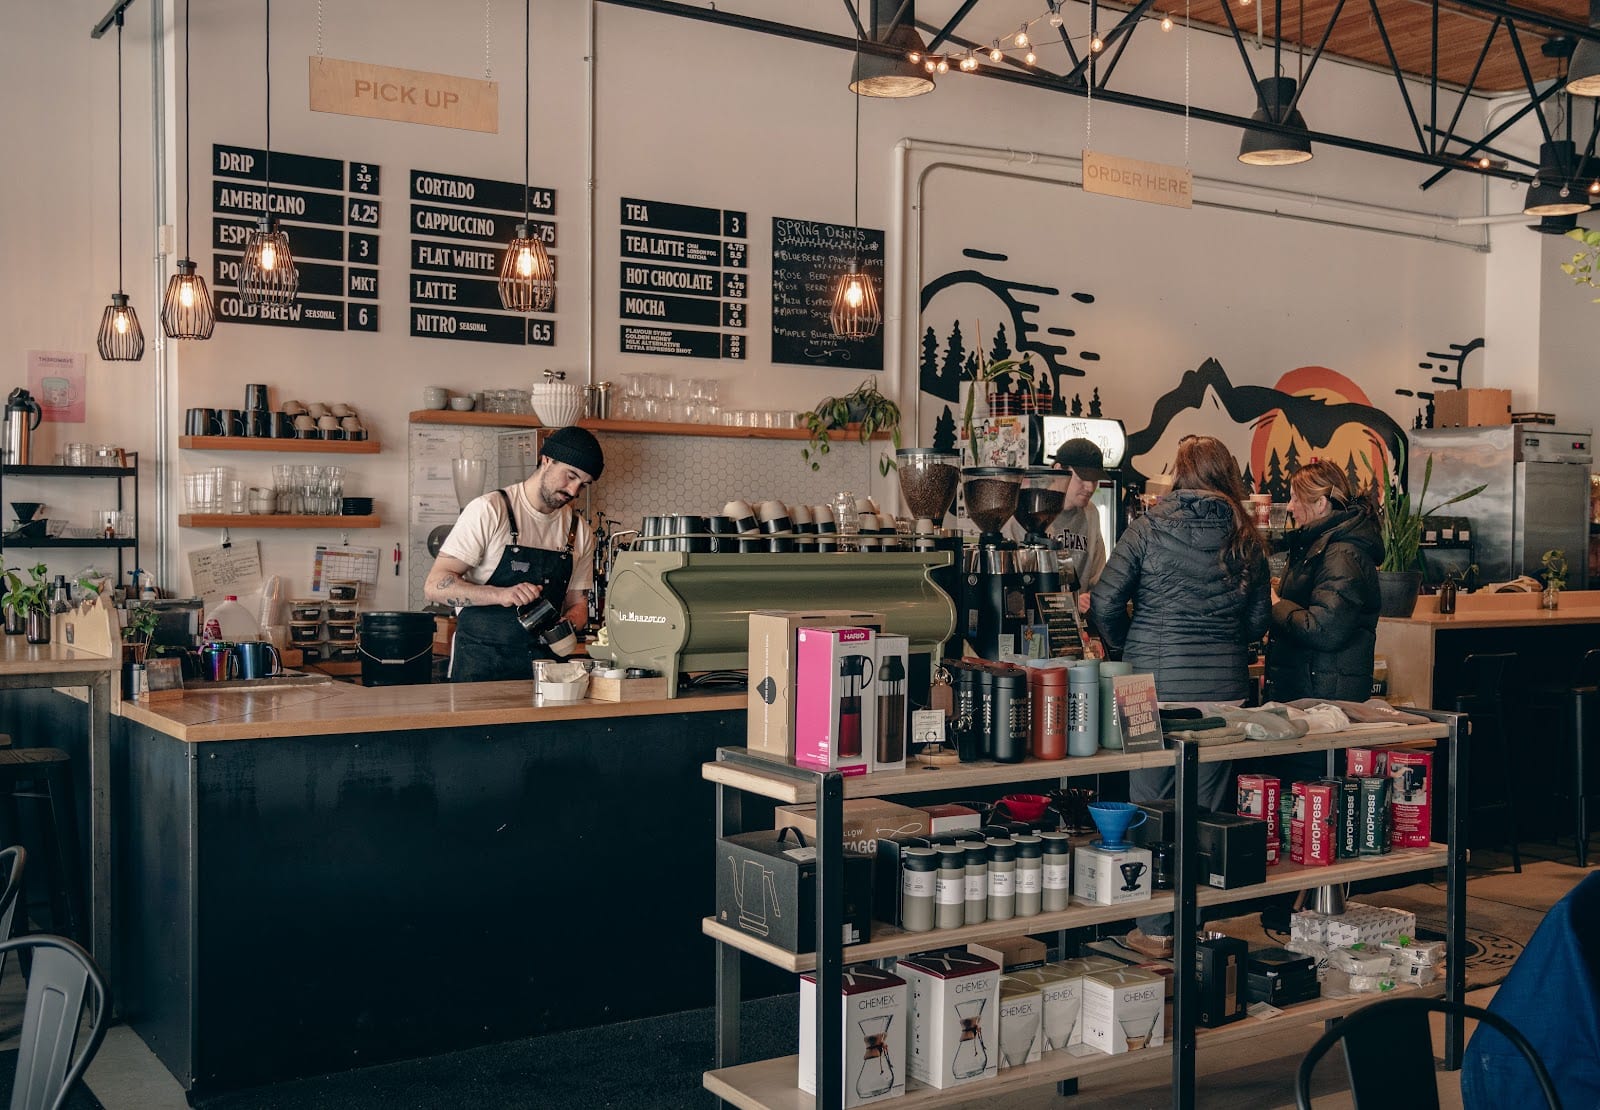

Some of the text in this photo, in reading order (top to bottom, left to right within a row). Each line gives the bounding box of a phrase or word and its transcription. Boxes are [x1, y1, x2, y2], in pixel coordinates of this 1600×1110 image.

[354, 79, 459, 109] PICK UP
[220, 152, 254, 173] DRIP
[360, 165, 367, 173] 3
[357, 173, 372, 183] 3.5
[1087, 164, 1188, 194] ORDER HERE
[360, 183, 369, 191] 4
[416, 176, 475, 200] CORTADO
[220, 188, 306, 216] AMERICANO
[533, 191, 552, 209] 4.5
[350, 204, 378, 224] 4.25
[626, 204, 649, 222] TEA
[416, 211, 495, 237] CAPPUCCINO
[731, 217, 740, 233] 3
[359, 240, 369, 257] 3
[626, 236, 684, 257] TEA LATTE
[727, 243, 745, 252] 4.75
[418, 246, 495, 270] FLAT WHITE
[730, 251, 742, 259] 5.5
[351, 276, 377, 292] MKT
[626, 267, 713, 291] HOT CHOCOLATE
[727, 281, 744, 290] 4.75
[733, 274, 739, 282] 4
[416, 280, 457, 301] LATTE
[220, 298, 337, 322] COLD BREW SEASONAL
[625, 298, 666, 317] MOCHA
[729, 303, 742, 311] 5.5
[358, 308, 369, 326] 6
[416, 314, 488, 334] NITRO SEASONAL
[729, 319, 742, 327] 6.5
[532, 323, 551, 342] 6.5
[843, 632, 865, 640] HARIO
[844, 829, 863, 838] LLOW
[843, 839, 877, 854] TAGG
[955, 980, 988, 994] CHEMEX
[858, 994, 895, 1010] CHEMEX
[1043, 989, 1073, 1003] CHEMEX
[1123, 990, 1155, 1003] CHEMEX
[1000, 1003, 1033, 1018] CHEMEX
